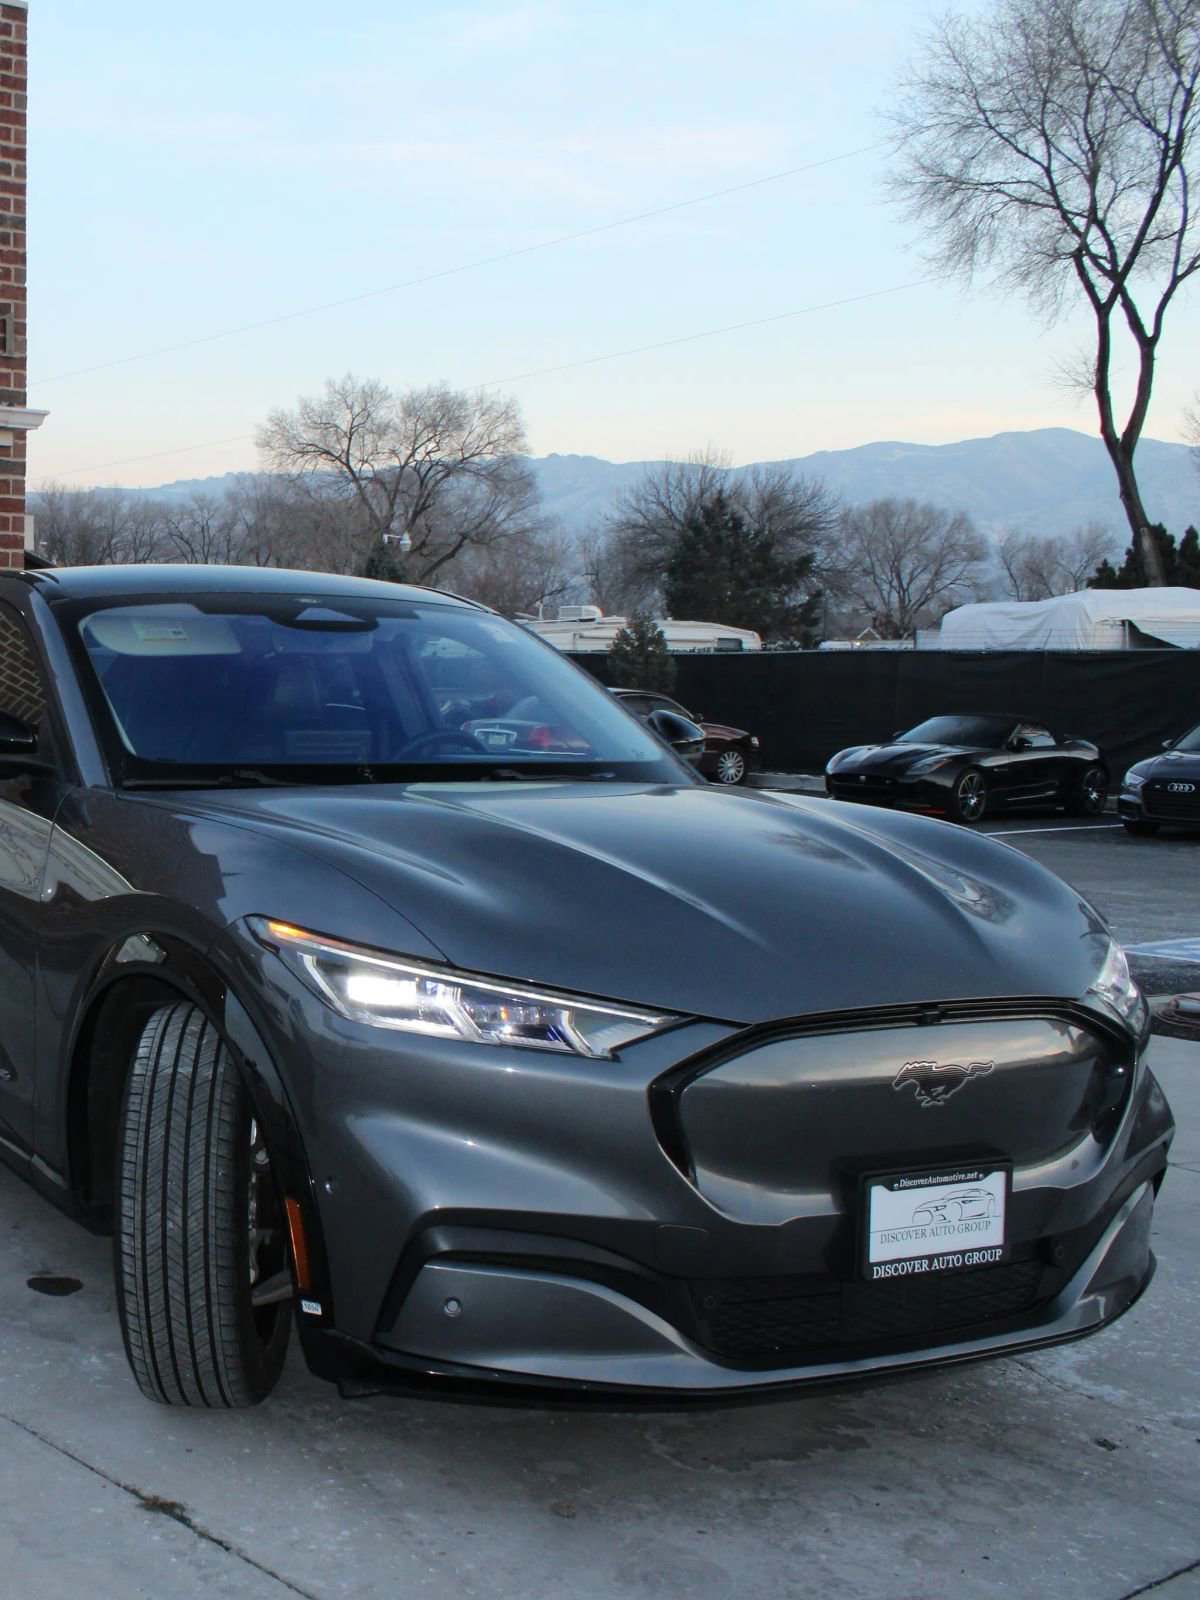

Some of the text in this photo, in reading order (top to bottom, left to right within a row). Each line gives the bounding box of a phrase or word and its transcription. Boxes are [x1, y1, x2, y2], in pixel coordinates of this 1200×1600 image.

[899, 1171, 978, 1188] DiscoverAutomotive.net
[880, 1220, 991, 1245] DISCOVER AUTO GROUP
[872, 1248, 1003, 1279] DISCOVER AUTO GROUP
